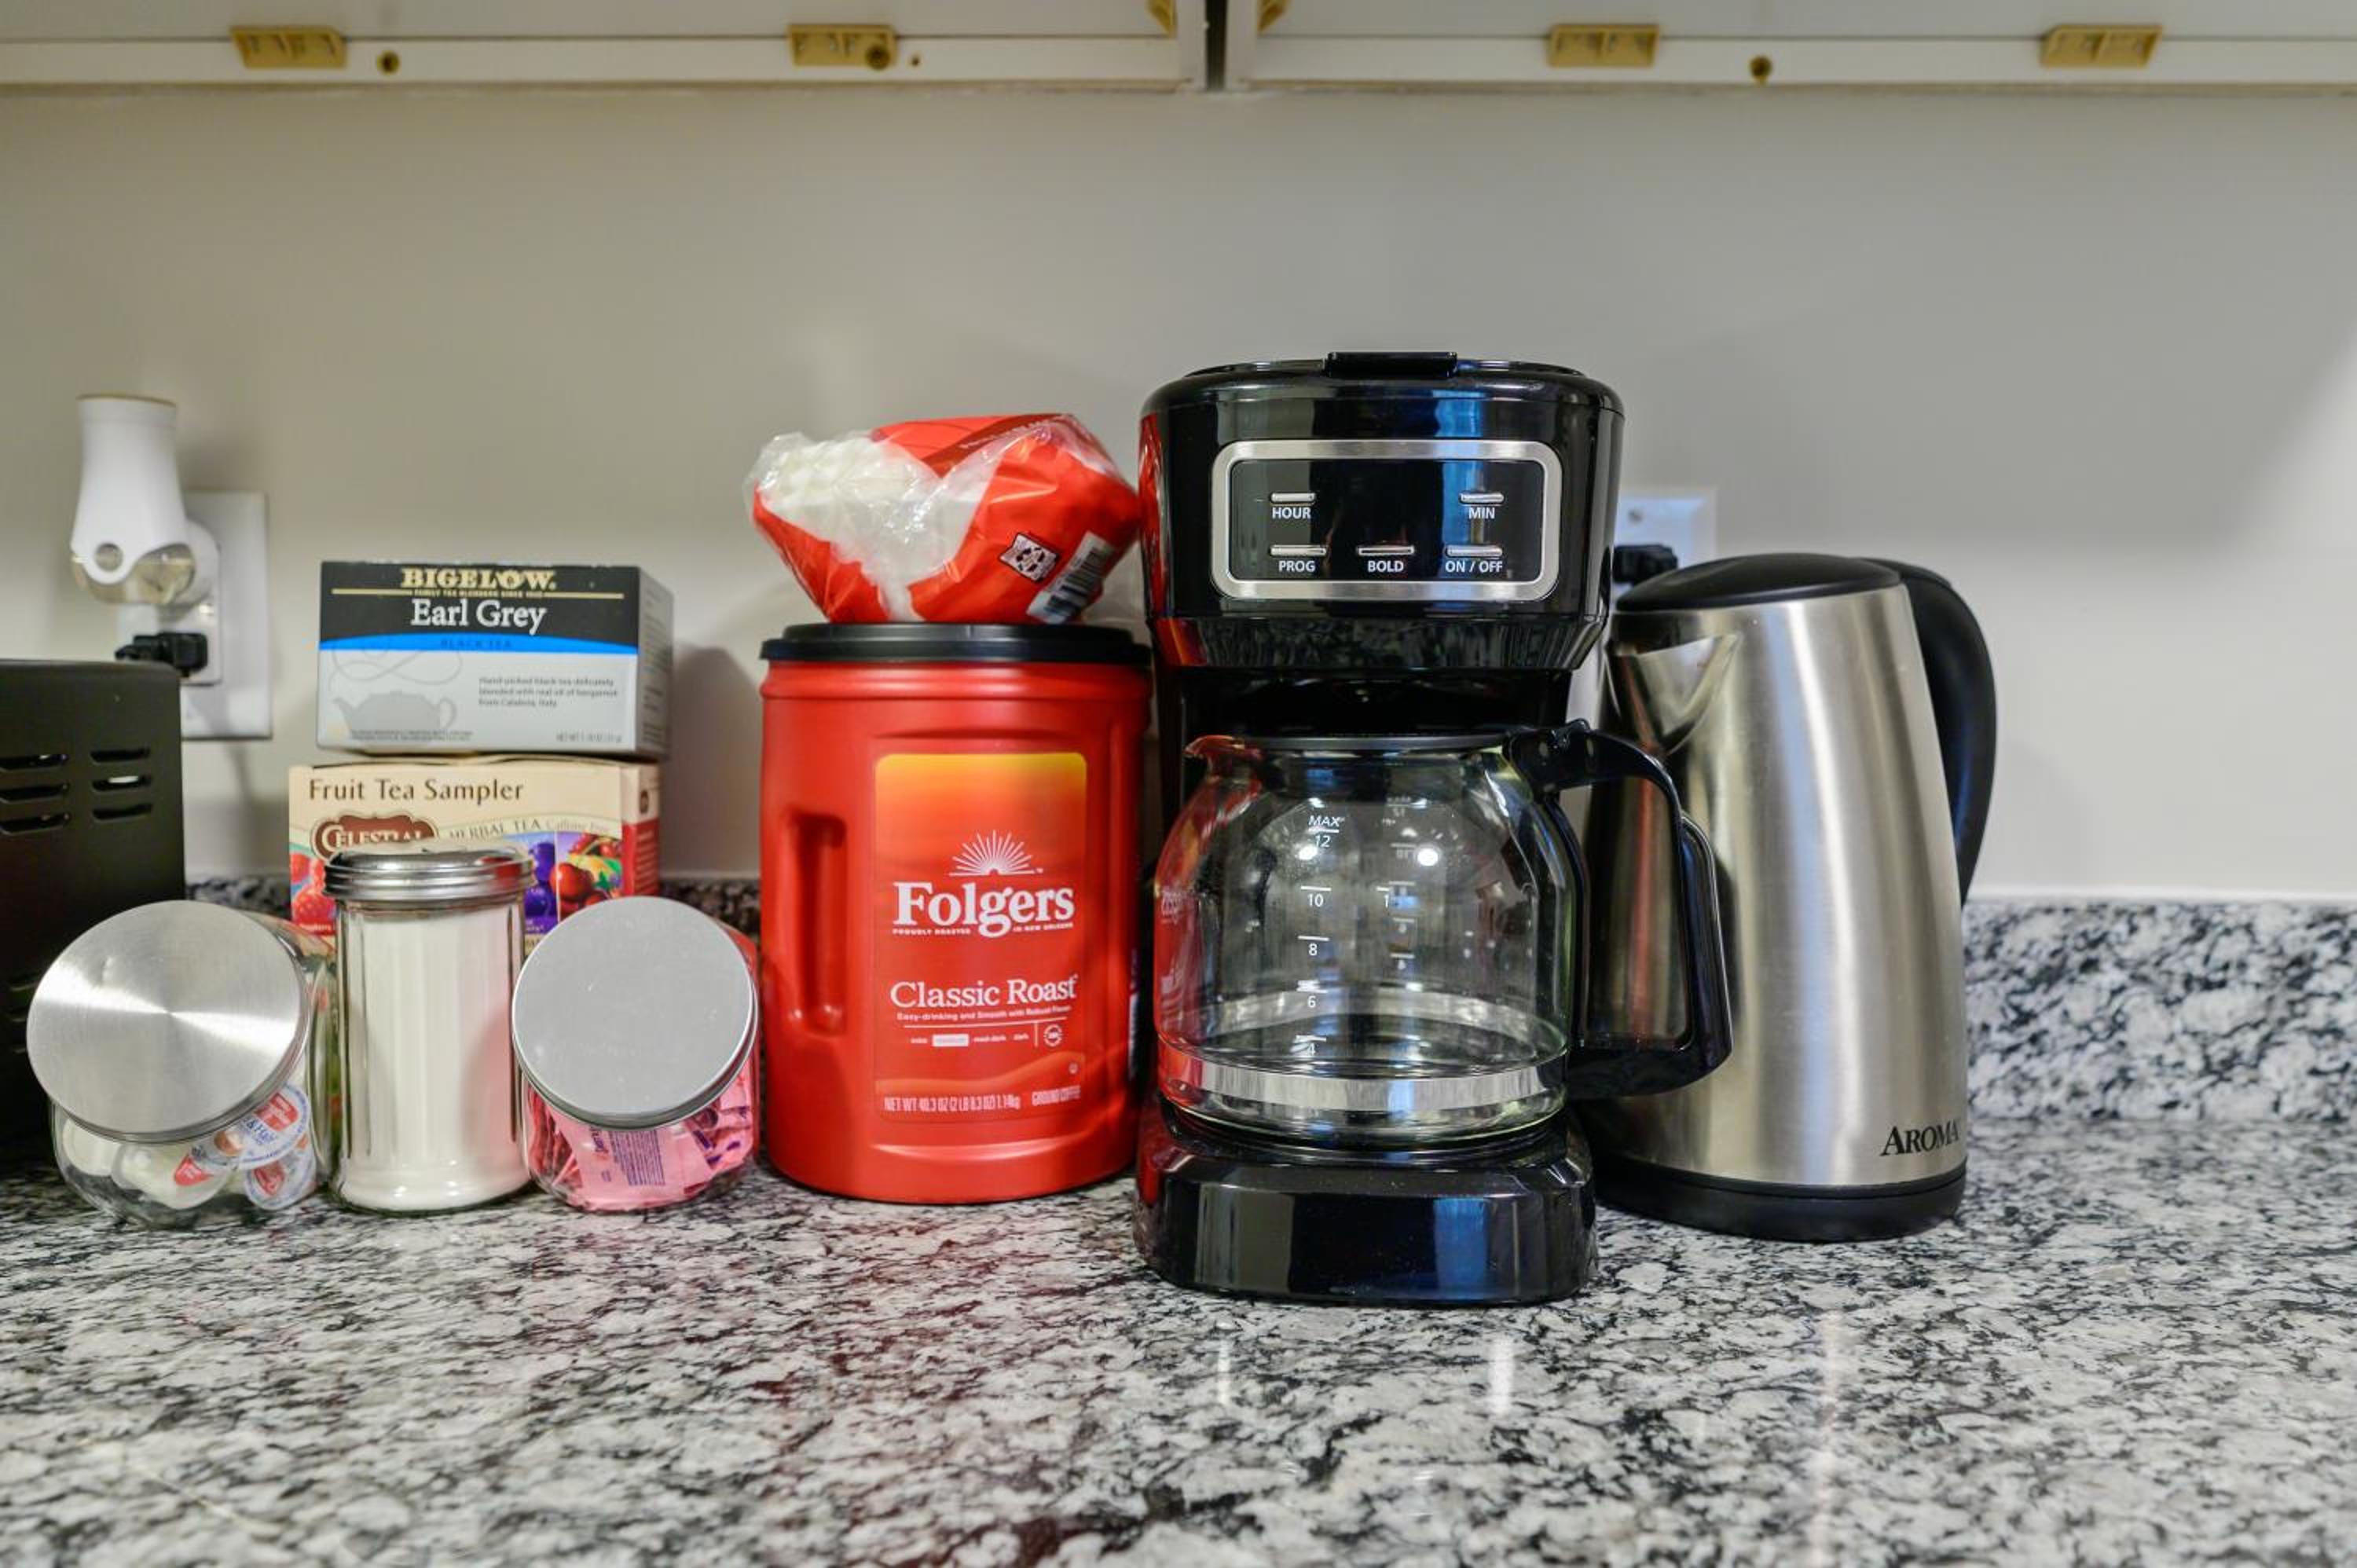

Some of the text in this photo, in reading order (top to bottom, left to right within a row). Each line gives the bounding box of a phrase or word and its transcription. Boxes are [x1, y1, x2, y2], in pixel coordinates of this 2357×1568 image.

[1272, 507, 1311, 519] HOUR
[1468, 507, 1496, 519] MIN
[1278, 560, 1316, 573] PROG
[1367, 560, 1404, 573] BOLD
[1479, 560, 1503, 573] OFF
[411, 598, 548, 636] Earl Grey
[309, 778, 524, 805] Fruit Tea Sampler
[515, 819, 542, 831] TEA
[1315, 835, 1330, 848] 12
[1307, 895, 1324, 907] 10
[893, 881, 1076, 938] Folgers
[1308, 943, 1318, 956] 8
[890, 975, 1077, 1009] Classic Roast
[1307, 995, 1316, 1008] 6
[1306, 1043, 1315, 1056] 4
[1879, 1119, 1960, 1156] AROMA
